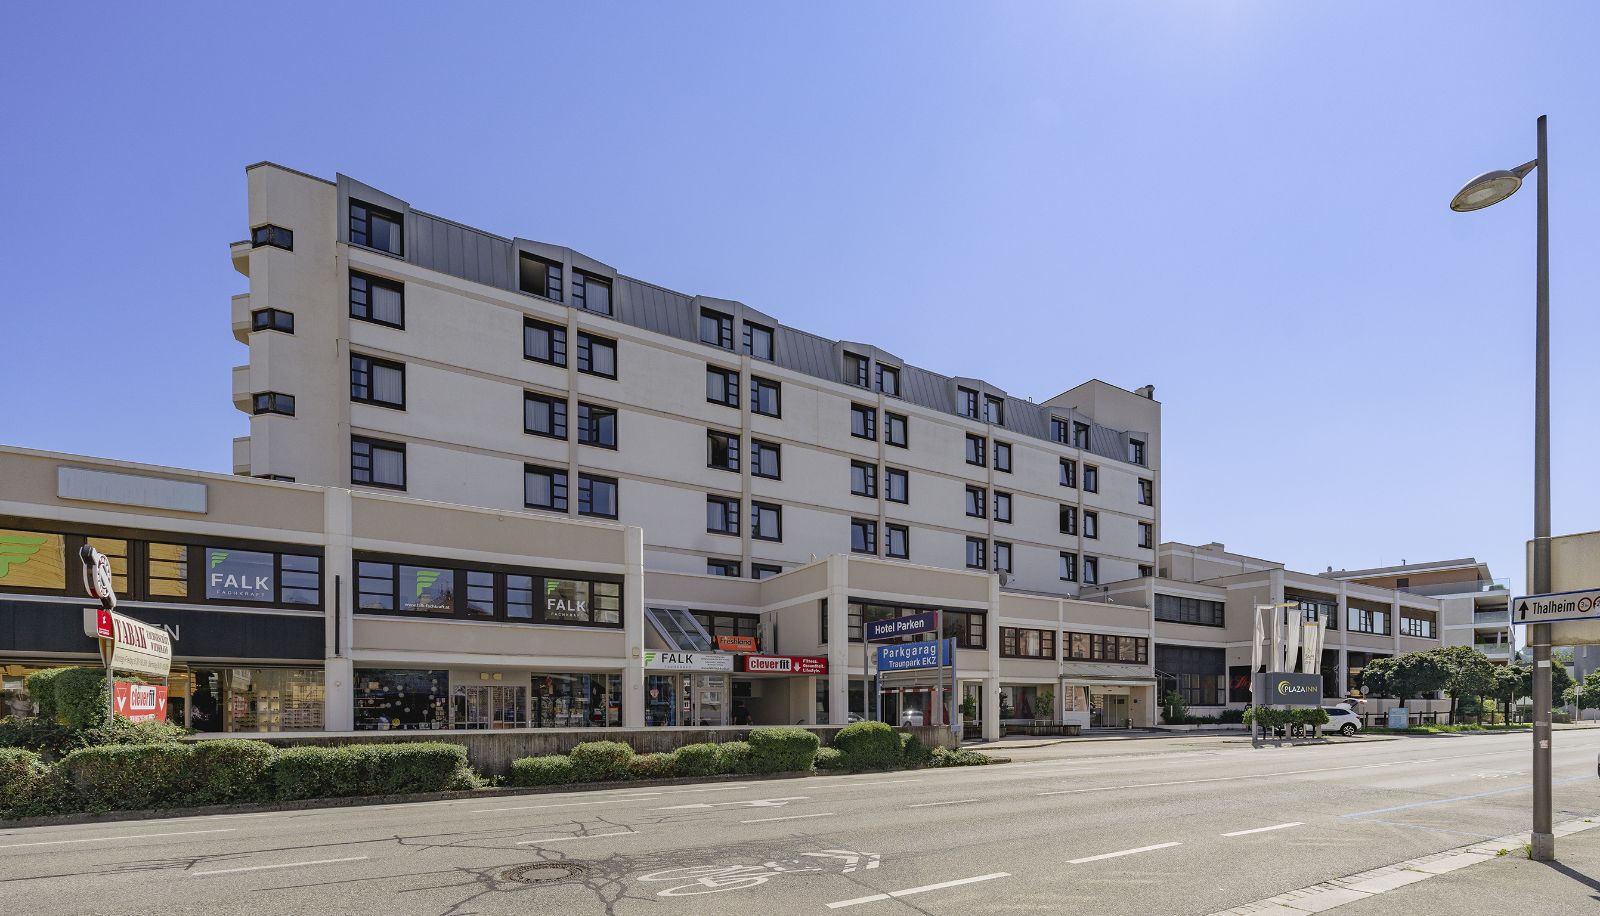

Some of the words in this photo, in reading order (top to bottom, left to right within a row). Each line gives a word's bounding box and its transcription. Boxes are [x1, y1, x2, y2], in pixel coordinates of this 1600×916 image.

[211, 573, 269, 591] FALK
[547, 598, 586, 612] FALK
[1532, 600, 1575, 615] Thalheim
[114, 618, 147, 649] TABAK
[875, 622, 895, 635] Hotel
[896, 619, 925, 632] Parken
[661, 652, 693, 665] FALK
[922, 656, 937, 666] EKZ
